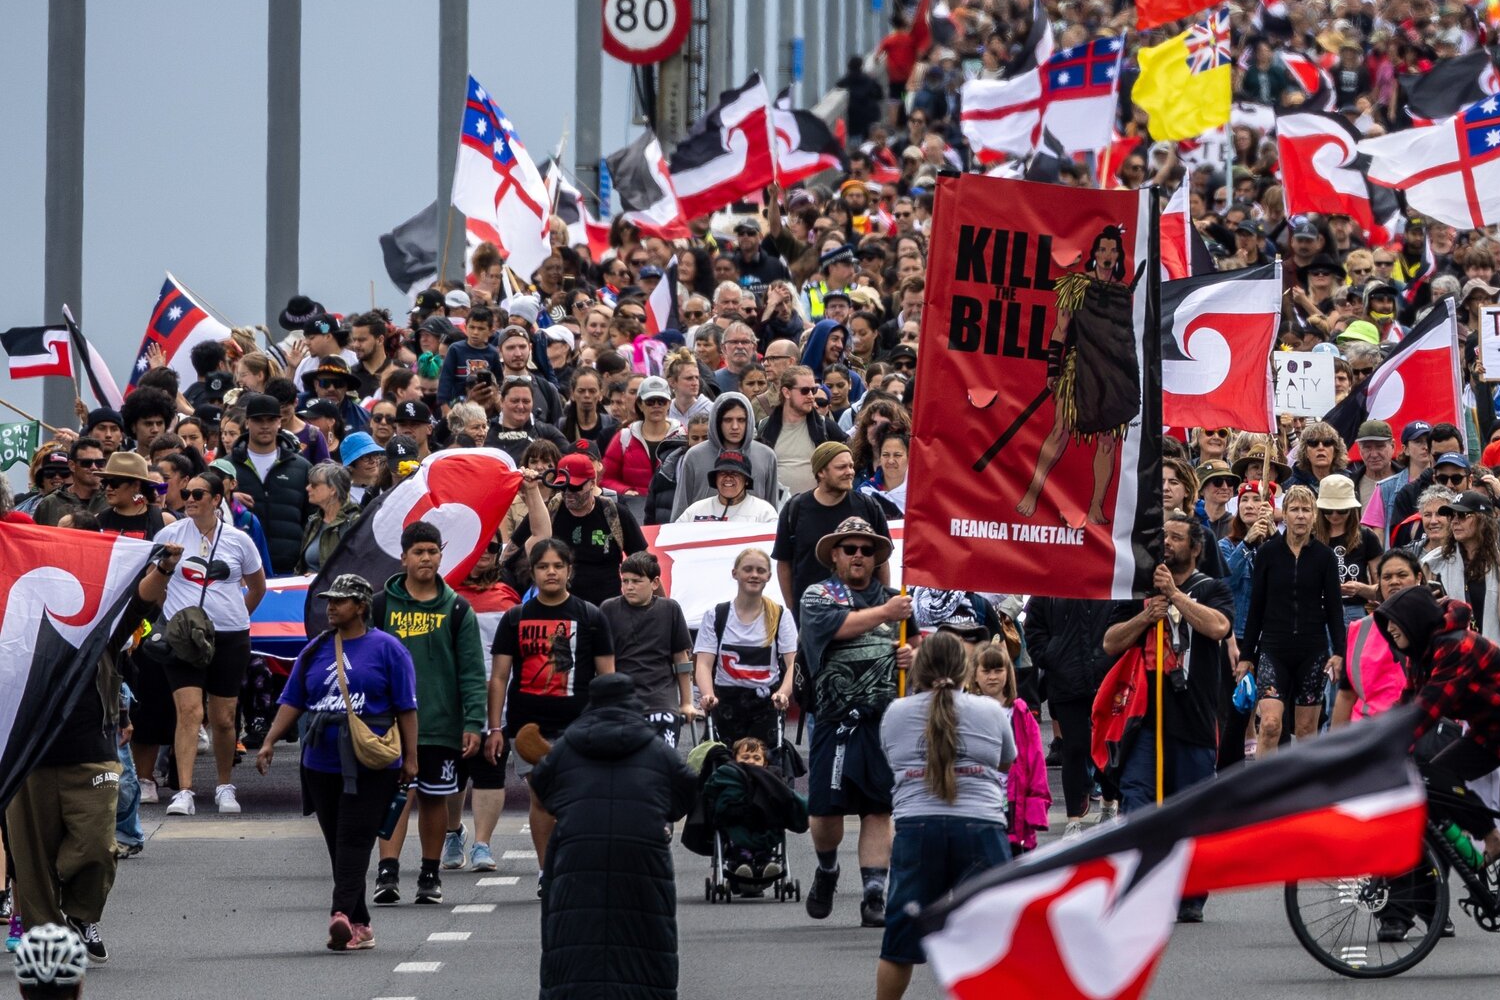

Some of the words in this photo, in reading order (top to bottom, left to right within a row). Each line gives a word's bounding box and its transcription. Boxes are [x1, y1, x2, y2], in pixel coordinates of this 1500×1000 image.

[955, 224, 1057, 292] KILL
[995, 285, 1017, 300] THE
[948, 295, 1052, 361] BILL
[397, 444, 406, 454] LA
[950, 518, 1008, 540] REANGA
[1011, 524, 1085, 546] TAKETAKE
[390, 611, 446, 629] MARIST
[521, 625, 548, 640] KILL
[92, 774, 104, 787] LOS
